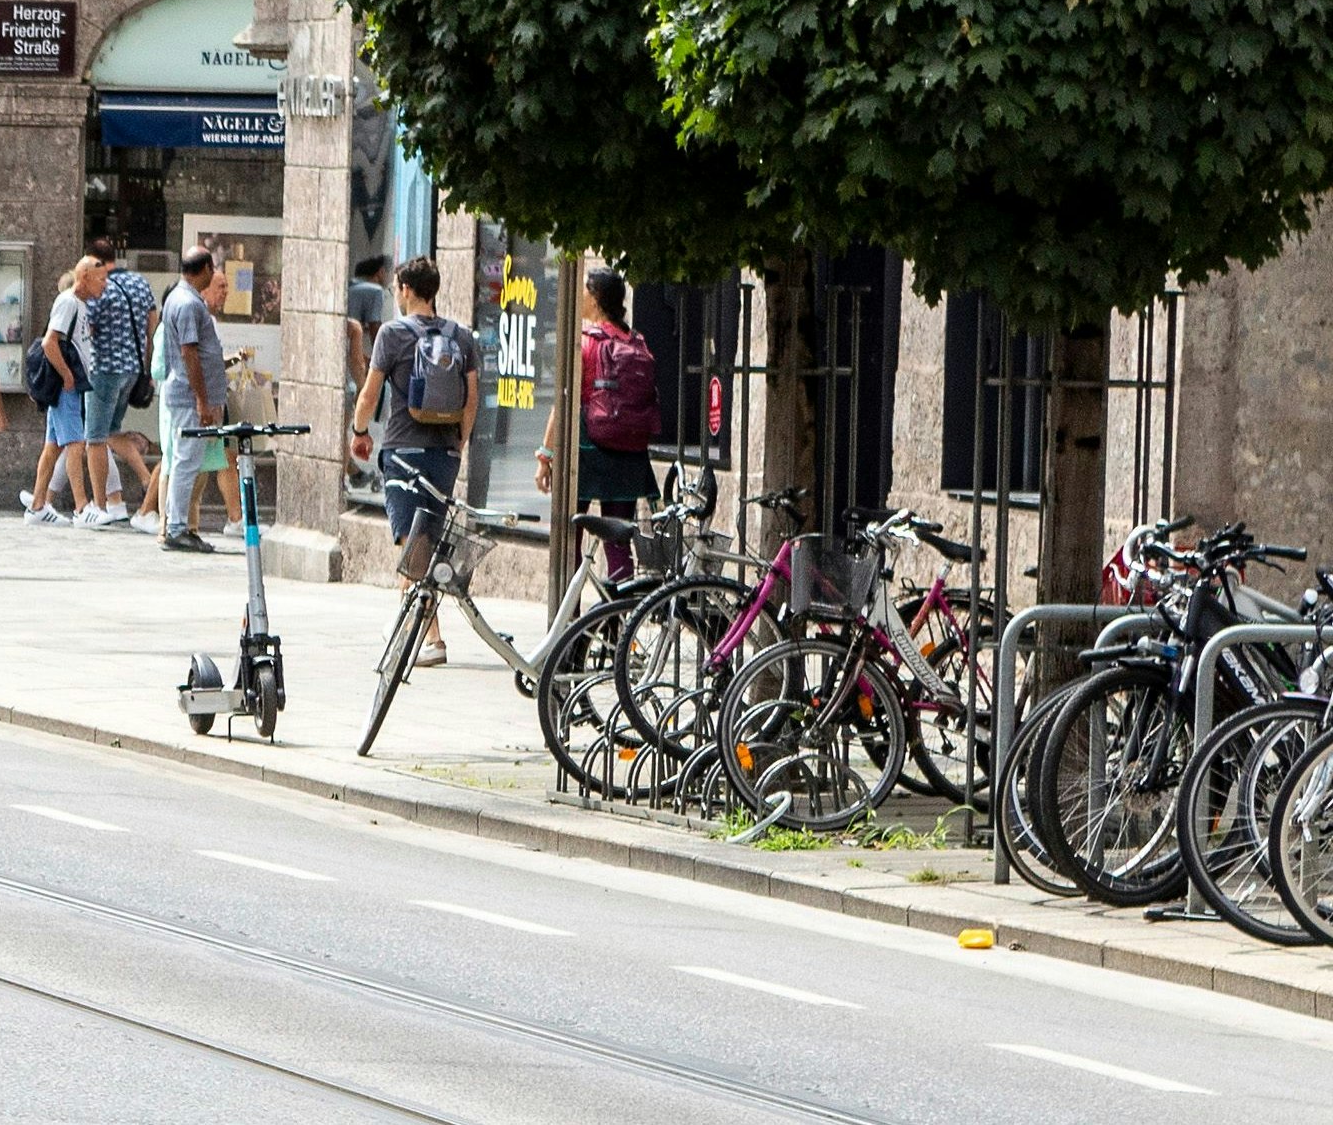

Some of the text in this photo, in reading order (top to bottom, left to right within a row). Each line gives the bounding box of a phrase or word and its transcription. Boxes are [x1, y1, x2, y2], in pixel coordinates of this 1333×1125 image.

[13, 4, 66, 24] Herzog-
[1, 22, 66, 38] Friedrich-
[14, 39, 60, 55] Straße
[202, 114, 265, 131] NÄGELE
[202, 133, 239, 143] WIENER
[498, 311, 537, 378] SALE
[497, 378, 517, 408] ALLES
